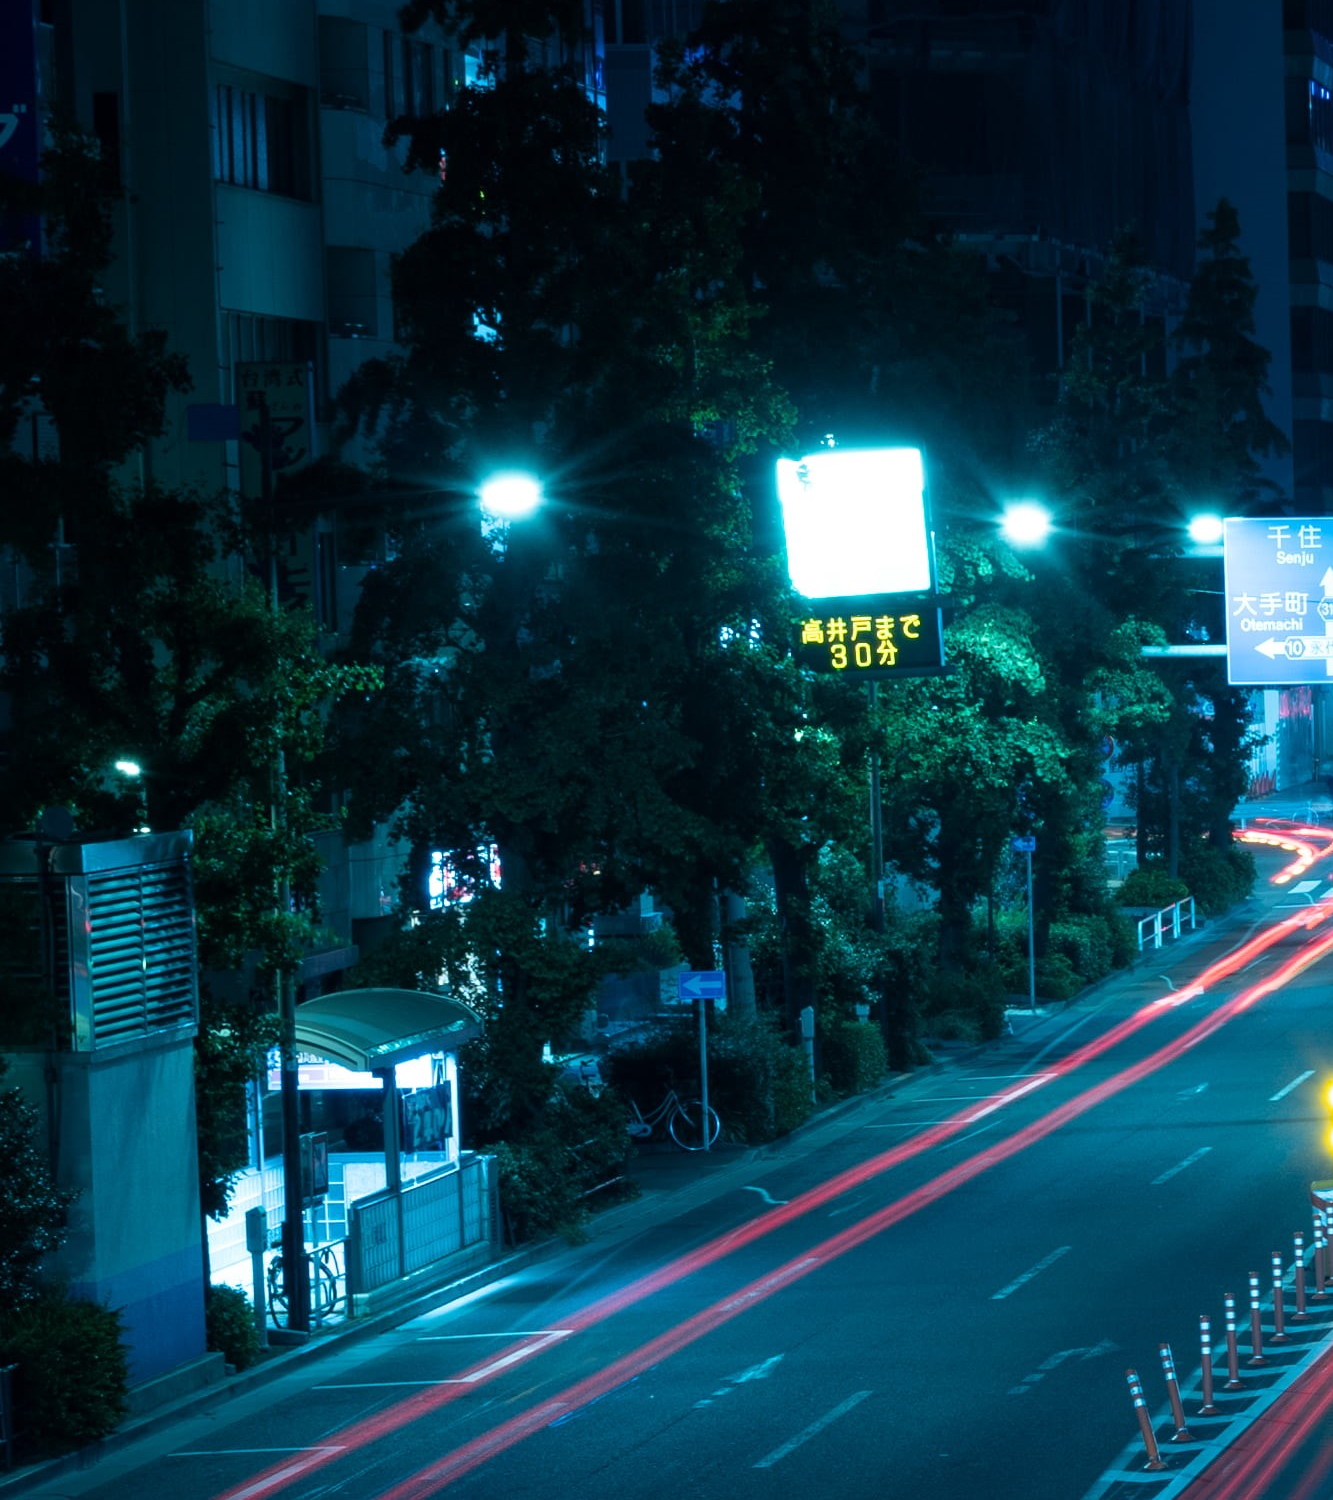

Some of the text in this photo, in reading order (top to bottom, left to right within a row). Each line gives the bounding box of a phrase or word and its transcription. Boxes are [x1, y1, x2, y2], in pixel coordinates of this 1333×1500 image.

[1267, 525, 1322, 549] 千住
[1276, 551, 1314, 565] Senju
[1233, 592, 1309, 616] 大手町
[801, 613, 920, 644] 高井戸まで
[1240, 618, 1303, 631] Otemachi
[830, 641, 898, 669] 30分
[1287, 641, 1303, 655] 10
